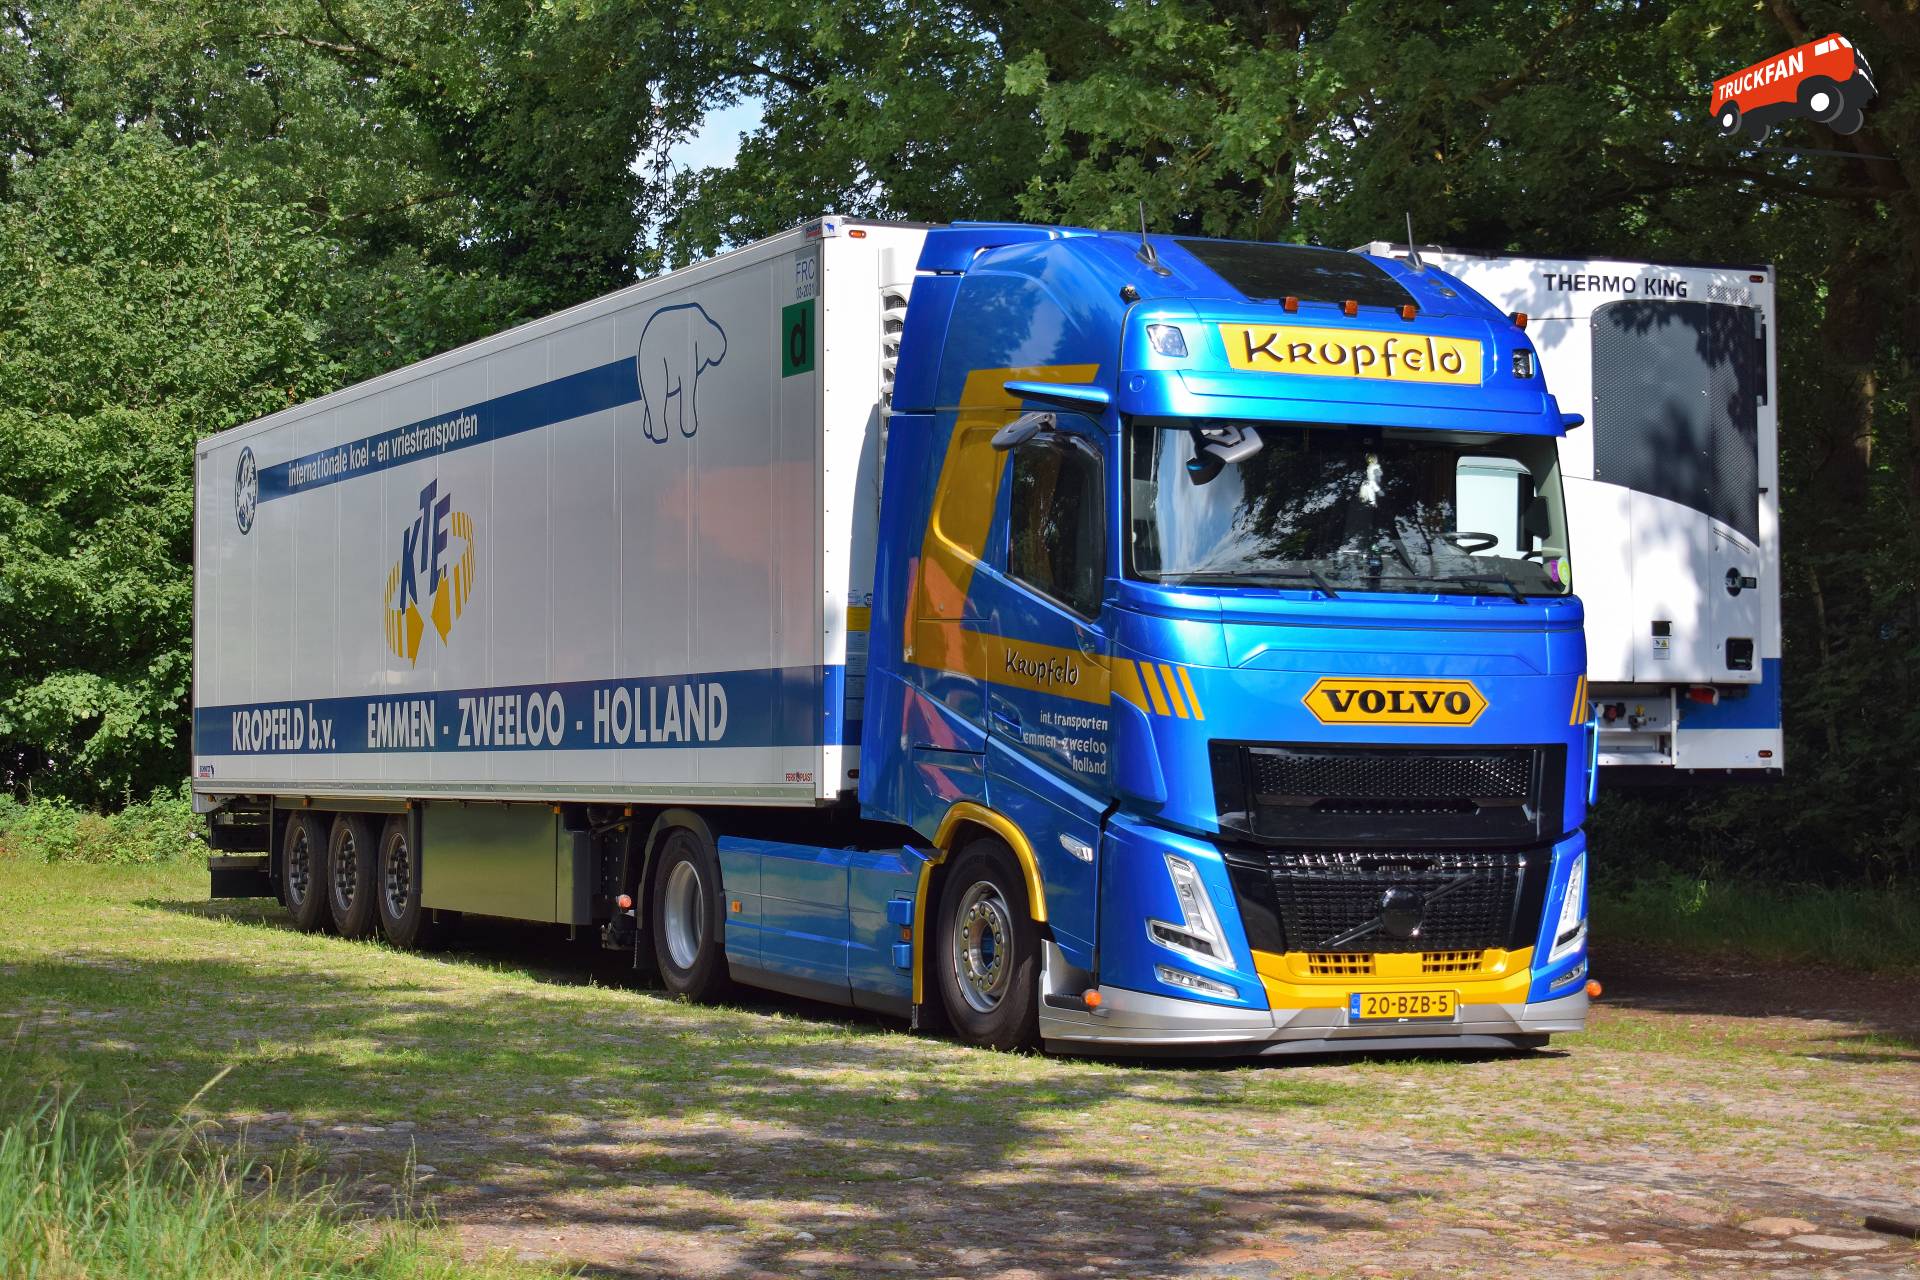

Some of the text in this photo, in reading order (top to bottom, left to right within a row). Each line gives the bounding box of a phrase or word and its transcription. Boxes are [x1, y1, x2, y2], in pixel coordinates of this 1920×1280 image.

[796, 258, 815, 281] FRC
[1543, 273, 1687, 298] THERMO KING
[288, 452, 347, 487] internationale
[350, 439, 369, 467] koel
[377, 441, 389, 462] en
[392, 411, 478, 457] vriestransporten
[1321, 689, 1471, 715] VOLVO
[232, 707, 305, 751] KROPFELD
[308, 702, 336, 750] b.v.
[367, 700, 435, 748] EMMEN
[457, 691, 565, 747] ZWEELOO
[593, 682, 728, 744] HOLLAND
[1054, 712, 1108, 731] transporten
[1073, 756, 1107, 775] holland
[1351, 1007, 1360, 1015] NL
[1367, 995, 1448, 1015] 20-BZB-5
